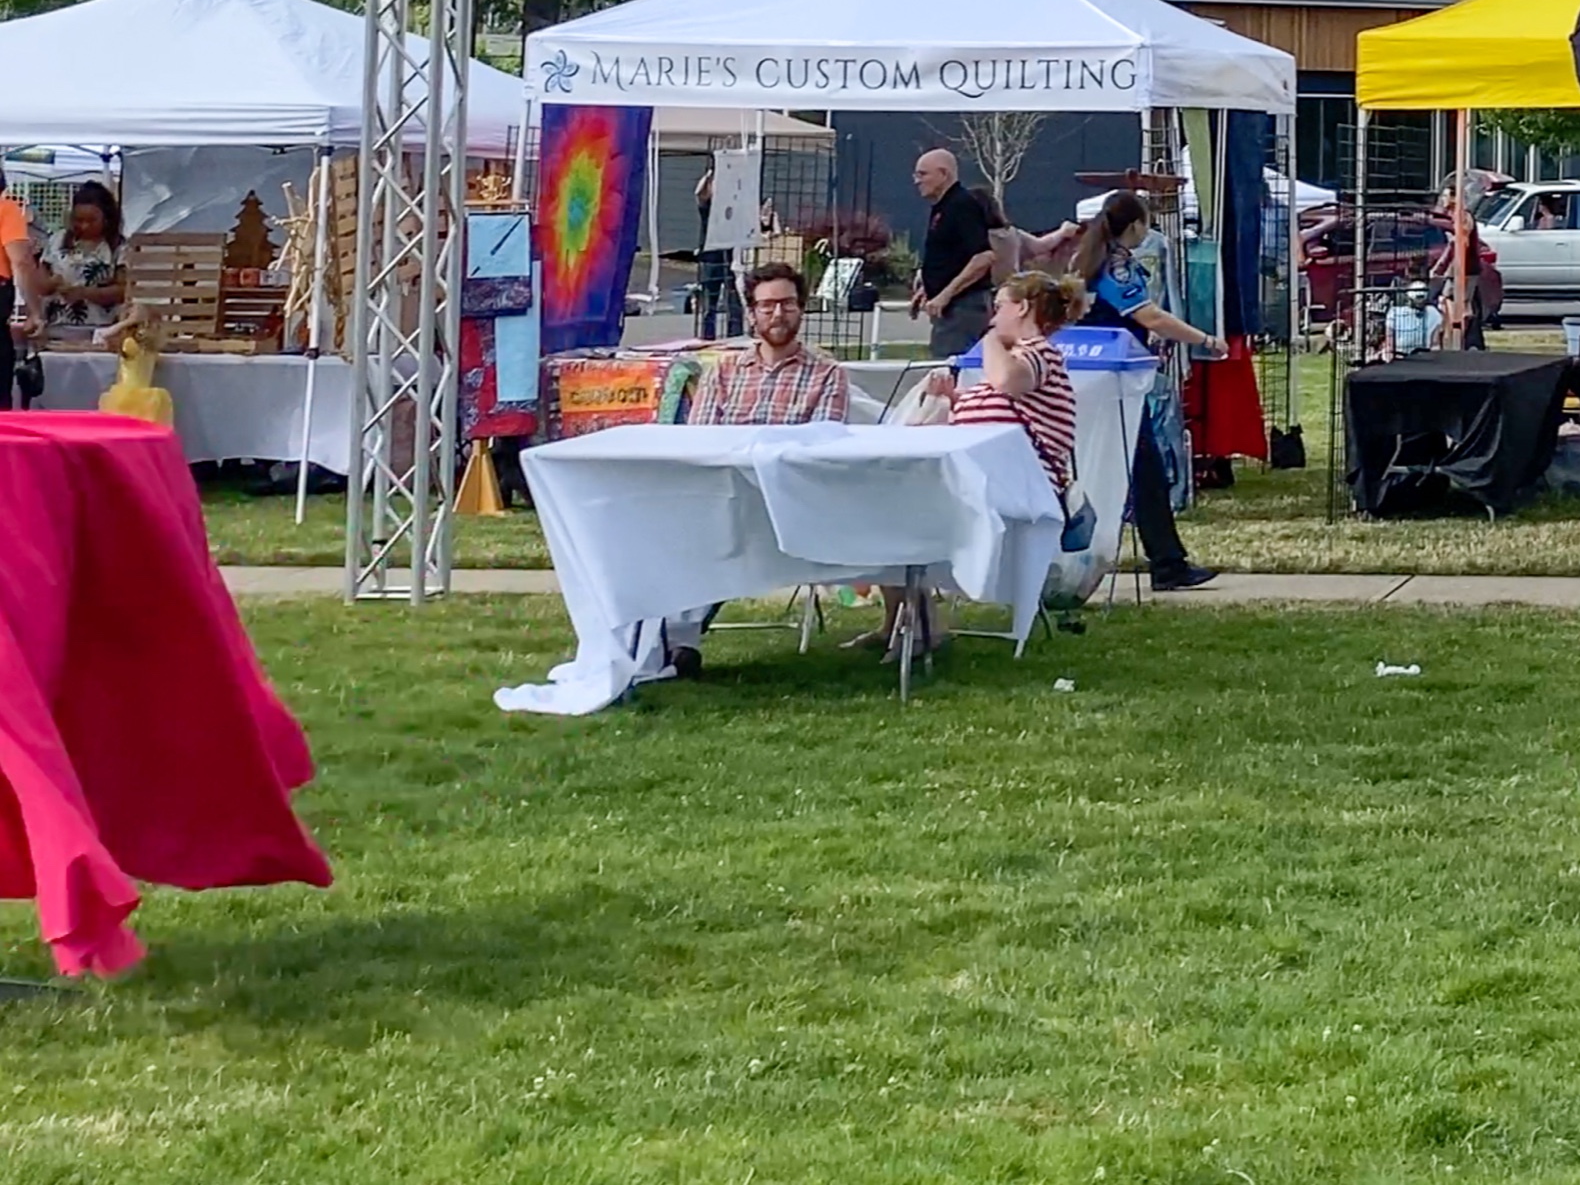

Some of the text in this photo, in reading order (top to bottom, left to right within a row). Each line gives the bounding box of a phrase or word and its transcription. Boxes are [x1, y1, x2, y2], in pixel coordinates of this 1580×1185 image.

[590, 52, 1138, 98] MARIE'S CUSTOM QUILTING
